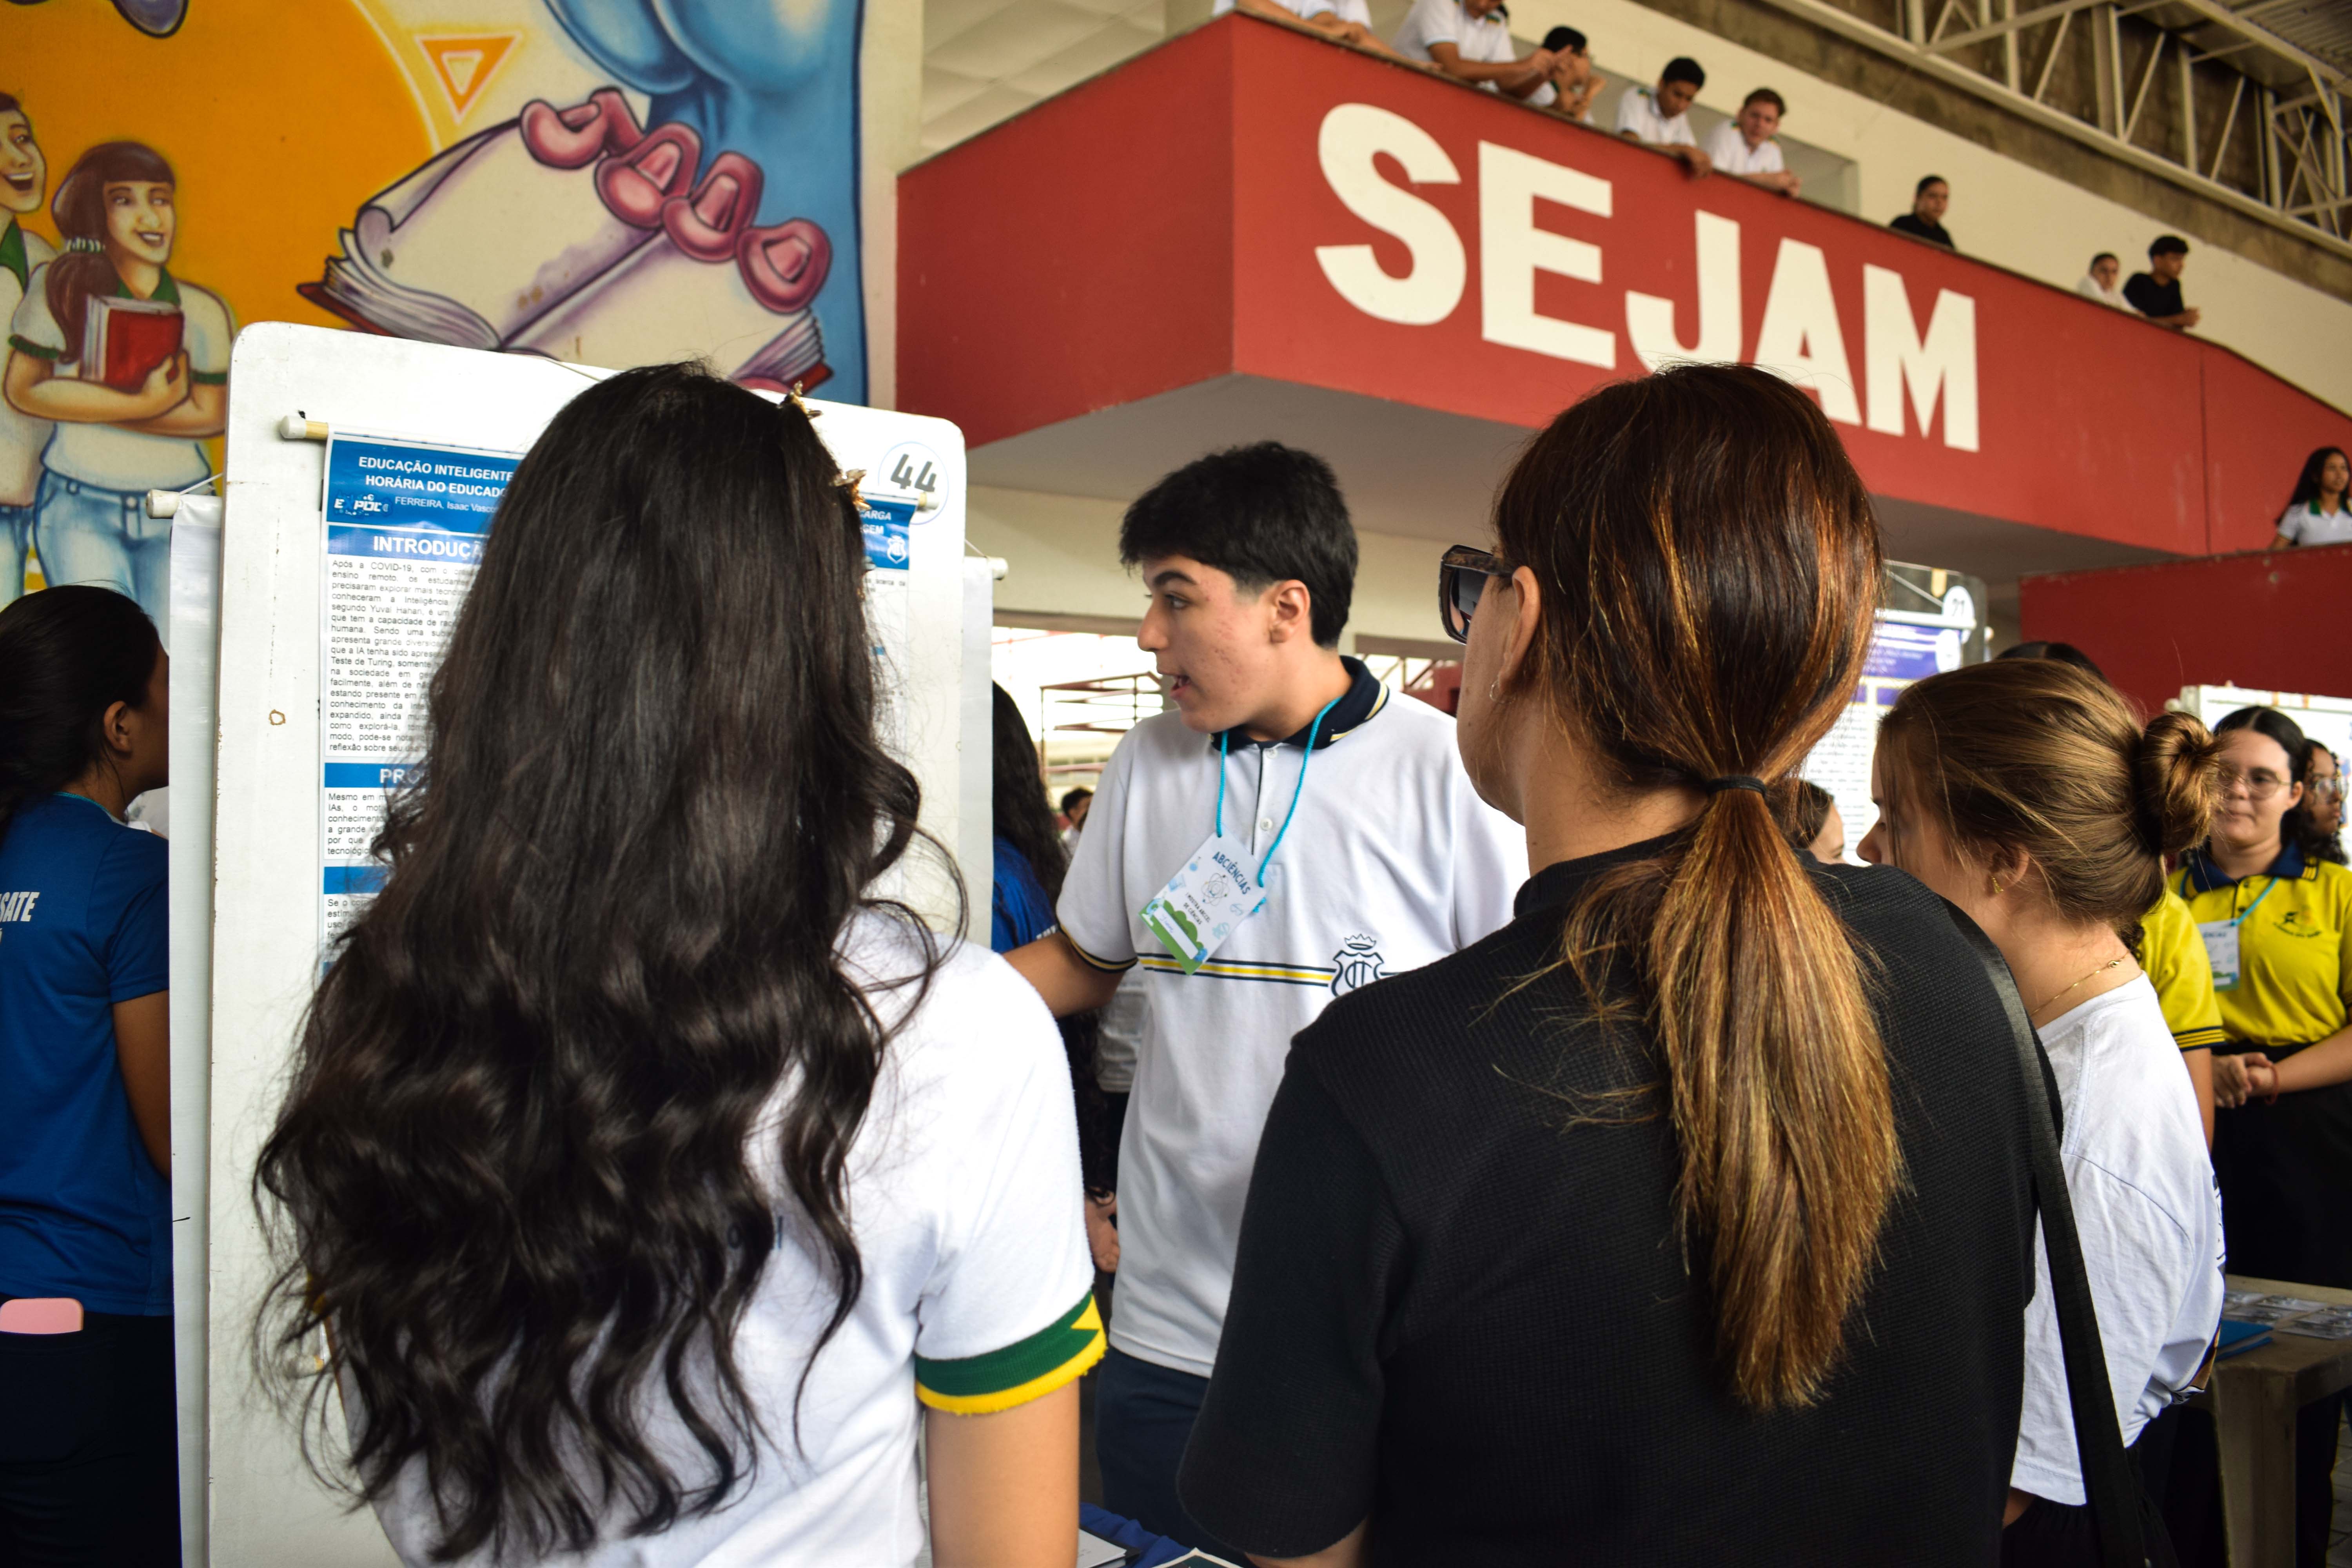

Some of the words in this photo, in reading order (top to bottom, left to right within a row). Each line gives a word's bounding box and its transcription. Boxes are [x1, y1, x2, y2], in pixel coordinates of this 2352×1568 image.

[1315, 102, 1980, 452] SEJAM
[358, 456, 432, 474] EDUCAÇÃO
[434, 464, 514, 481] INTELIGENTE
[891, 454, 936, 492] 44
[365, 475, 425, 490] HORÁRIA
[427, 481, 446, 492] DO
[446, 501, 469, 511] Isaac
[373, 536, 483, 560] INTRODUÇÃ
[332, 560, 353, 568] Após
[332, 582, 376, 591] precisaram
[332, 593, 381, 602] conheceram
[405, 596, 448, 606] Inteligência
[332, 604, 366, 612] segundo
[377, 617, 423, 625] capacidade
[331, 656, 352, 664] Teste
[330, 678, 373, 688] facilmente,
[330, 711, 374, 720] expandido,
[379, 768, 421, 784] PRO
[338, 826, 366, 834] grande
[0, 891, 40, 922] SATE
